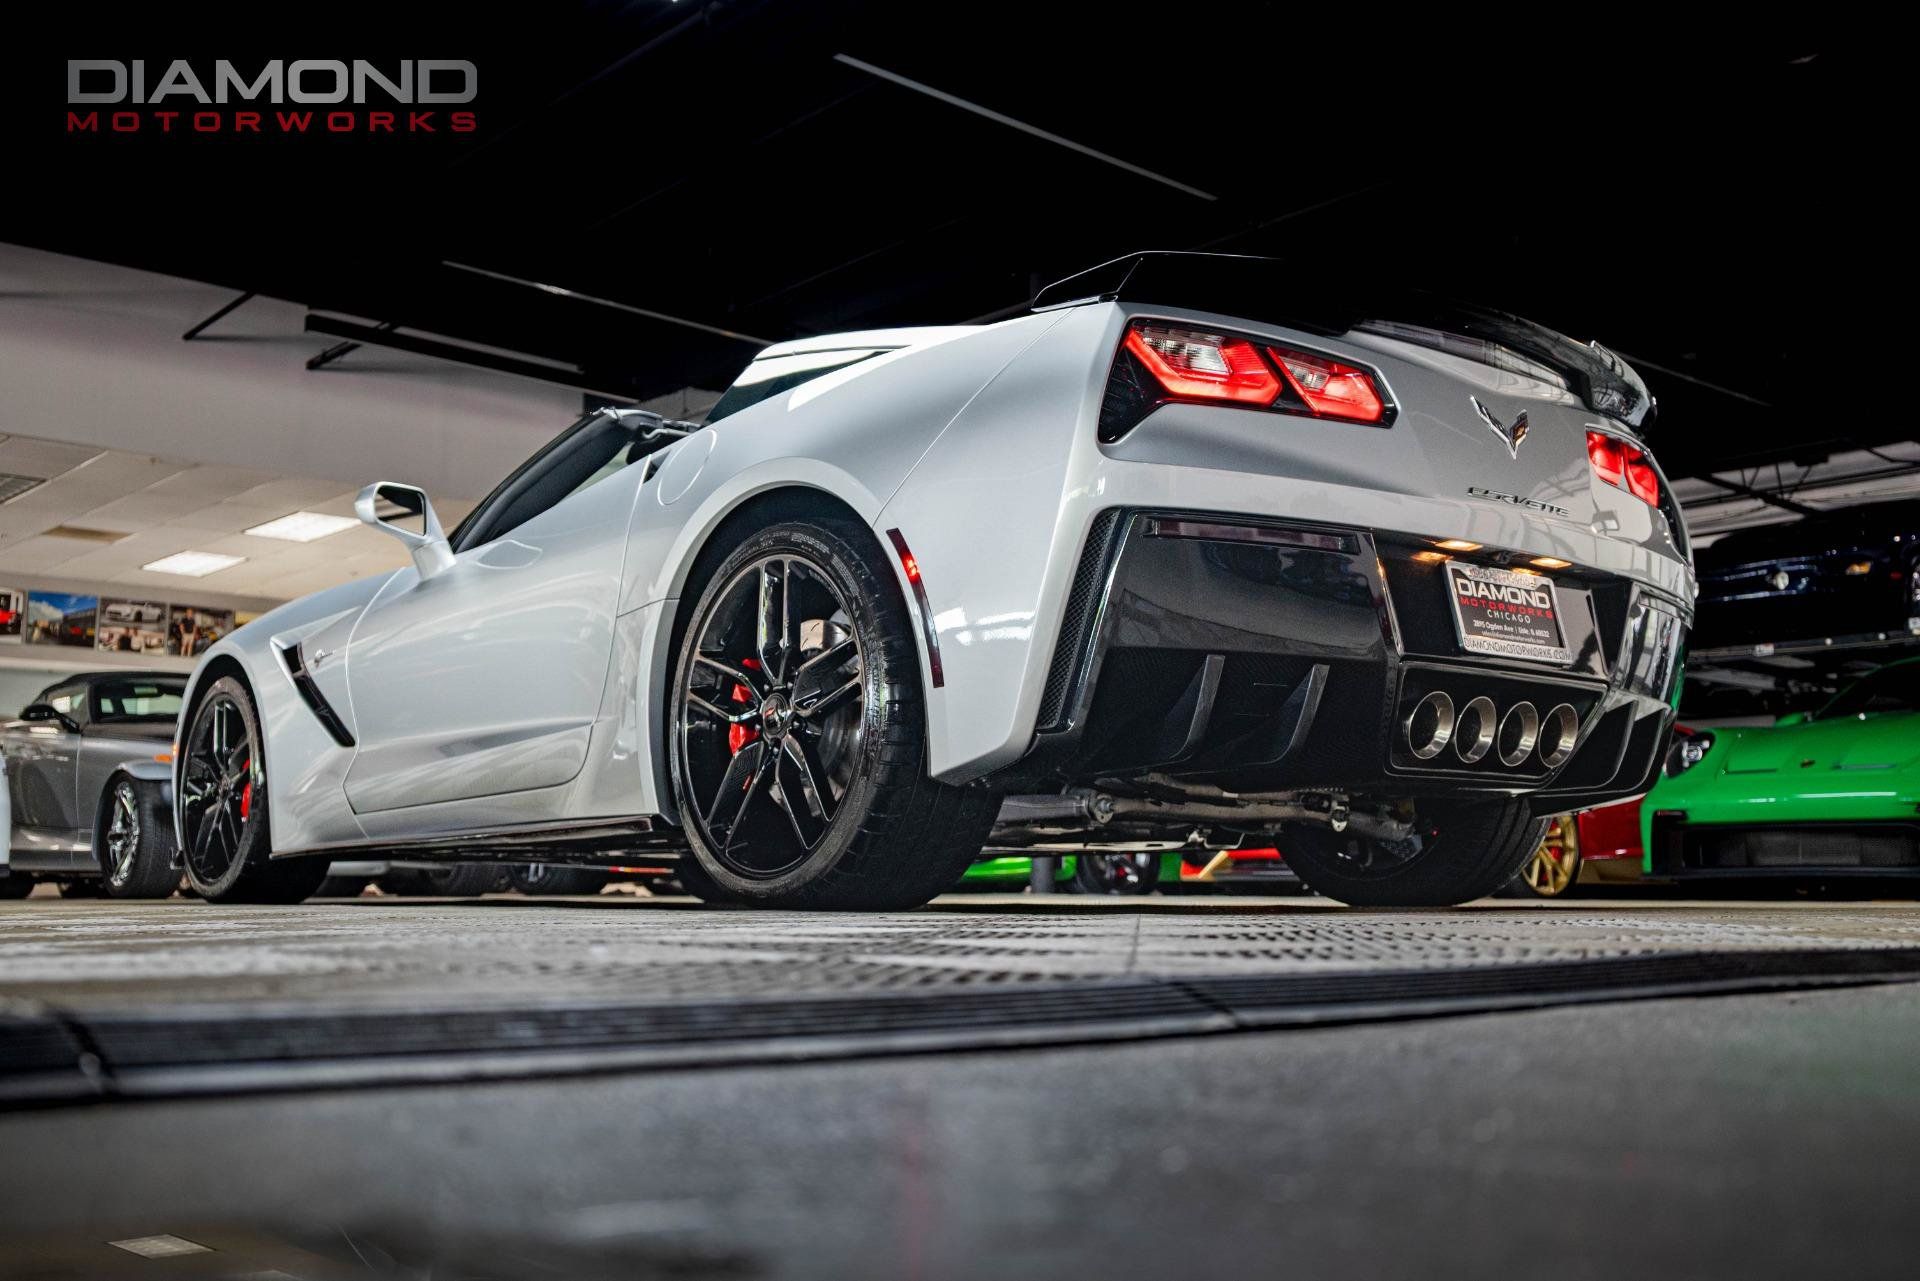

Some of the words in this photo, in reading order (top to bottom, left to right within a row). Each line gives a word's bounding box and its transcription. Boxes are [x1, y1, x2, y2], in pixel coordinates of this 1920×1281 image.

[1456, 577, 1551, 609] DIAMOND
[1460, 596, 1553, 619] MOTORWORKS
[1487, 609, 1531, 623] CHICAGO
